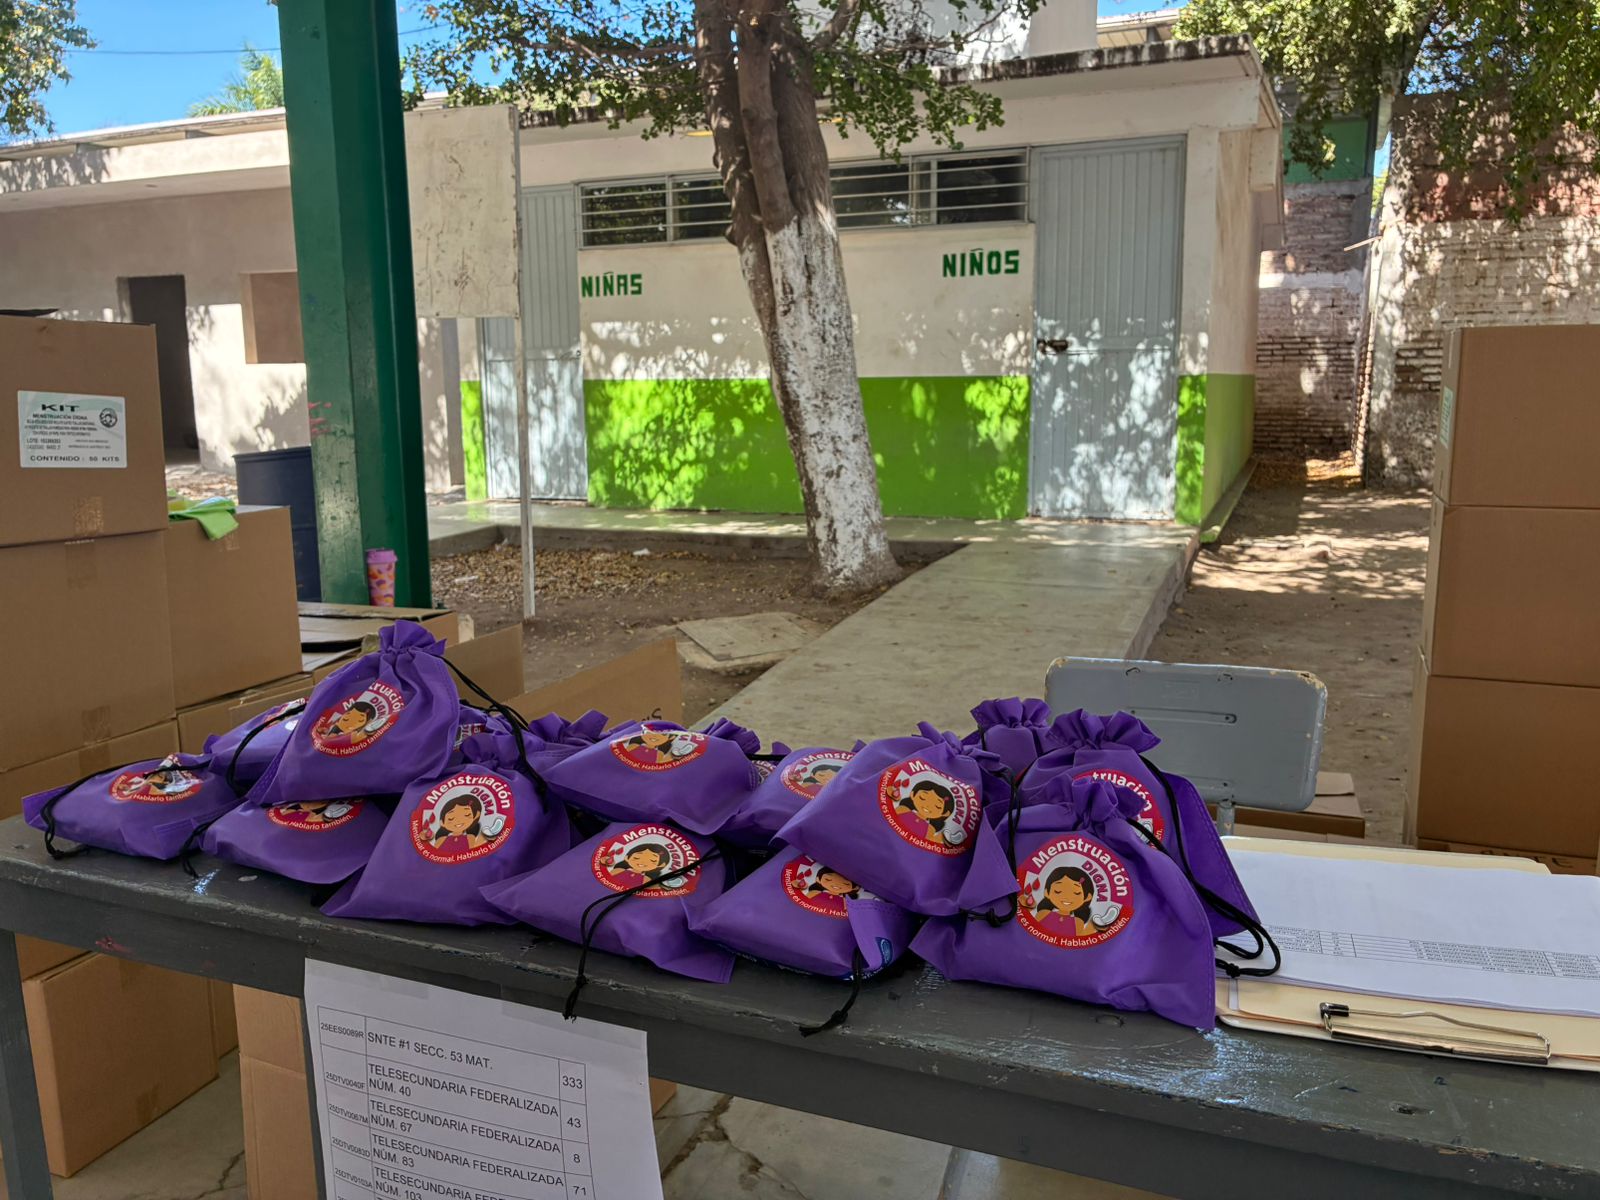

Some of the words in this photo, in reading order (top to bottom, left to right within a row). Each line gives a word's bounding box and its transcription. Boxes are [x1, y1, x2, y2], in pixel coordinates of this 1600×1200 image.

[943, 248, 1019, 277] NIÑOS
[581, 271, 642, 297] NIÑAS
[41, 404, 79, 412] KIT
[803, 752, 854, 763] Menstr
[426, 775, 511, 809] Menstruación
[884, 814, 909, 840] normal.
[909, 834, 941, 853] Hablarlo
[456, 848, 488, 861] Hablarlo
[622, 826, 700, 877] Menstruacin
[1031, 838, 1130, 897] Menstruación
[1081, 860, 1109, 902] DIGNA
[799, 900, 827, 914] normal.
[1020, 916, 1029, 926] es
[1027, 925, 1058, 945] normal.
[1060, 937, 1098, 947] Hablarlo
[1098, 916, 1130, 941] también.
[367, 1031, 396, 1047] SNTE
[399, 1039, 410, 1050] #1
[414, 1042, 447, 1060] SECC.
[450, 1050, 463, 1063] 53
[465, 1054, 493, 1070] MAT.
[368, 1063, 467, 1096] TELESECUNDARIA
[470, 1086, 559, 1117] FEDERALIZADA
[369, 1077, 397, 1094] NÚM.
[399, 1086, 411, 1097] 40
[562, 1075, 583, 1090] 333
[370, 1113, 397, 1130] NÚM.
[400, 1122, 412, 1133] 67
[370, 1100, 469, 1134] TELESECUNDARIA
[471, 1124, 561, 1154] FEDERALIZADA
[567, 1117, 582, 1128] 43
[372, 1133, 470, 1168] TELESECUNDARIA
[473, 1159, 564, 1187] FEDERALIZADA
[373, 1147, 399, 1164] NÚM.
[402, 1156, 415, 1168] 83
[573, 1153, 581, 1164] 8
[374, 1166, 472, 1200] TELESECUNDARIA
[375, 1180, 401, 1197] NÚM.
[404, 1190, 422, 1200] 103
[573, 1185, 587, 1196] 71
